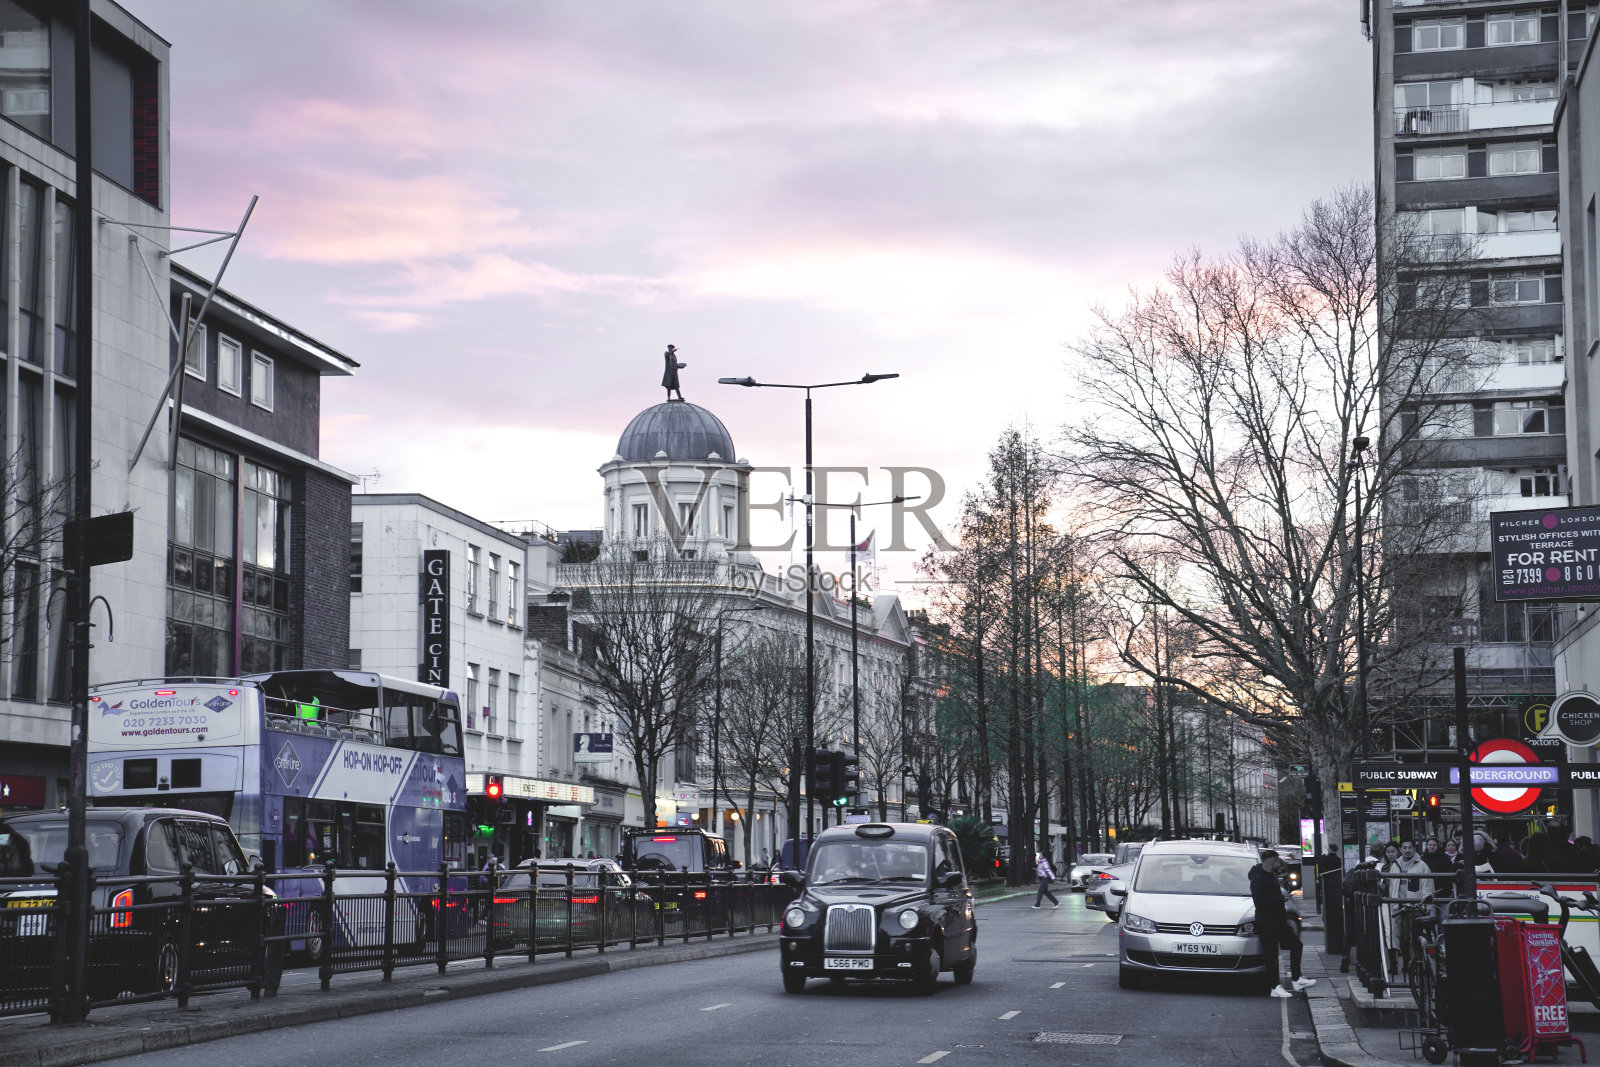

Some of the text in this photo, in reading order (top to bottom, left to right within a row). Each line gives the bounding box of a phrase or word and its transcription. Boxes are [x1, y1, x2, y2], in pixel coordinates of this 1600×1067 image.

[1500, 515, 1600, 528] PILCHER LONDON
[1498, 533, 1537, 542] STYLISH
[1539, 530, 1579, 540] OFFICES
[1529, 540, 1574, 549] TERRACE
[1507, 548, 1598, 567] FOR RENT
[1516, 567, 1542, 584] 7399
[1564, 564, 1600, 581] 860
[1504, 584, 1600, 595] www.pilcher.londo
[426, 558, 445, 635] GATE
[427, 643, 443, 686] CIN
[123, 715, 207, 727] 020 7233 7030
[1534, 709, 1547, 731] F
[121, 726, 208, 737] www.goldentours.com
[343, 749, 403, 775] HOP-ON HOP-OFF
[1360, 771, 1438, 779] PUBLIC SUBWAY
[1456, 770, 1552, 780] NDERGROUND
[1528, 931, 1554, 939] Evening
[1528, 938, 1558, 946] Standard
[1176, 943, 1218, 954] MT69 YNJ
[827, 958, 870, 968] LS66 PMO
[1534, 1005, 1566, 1021] FREE
